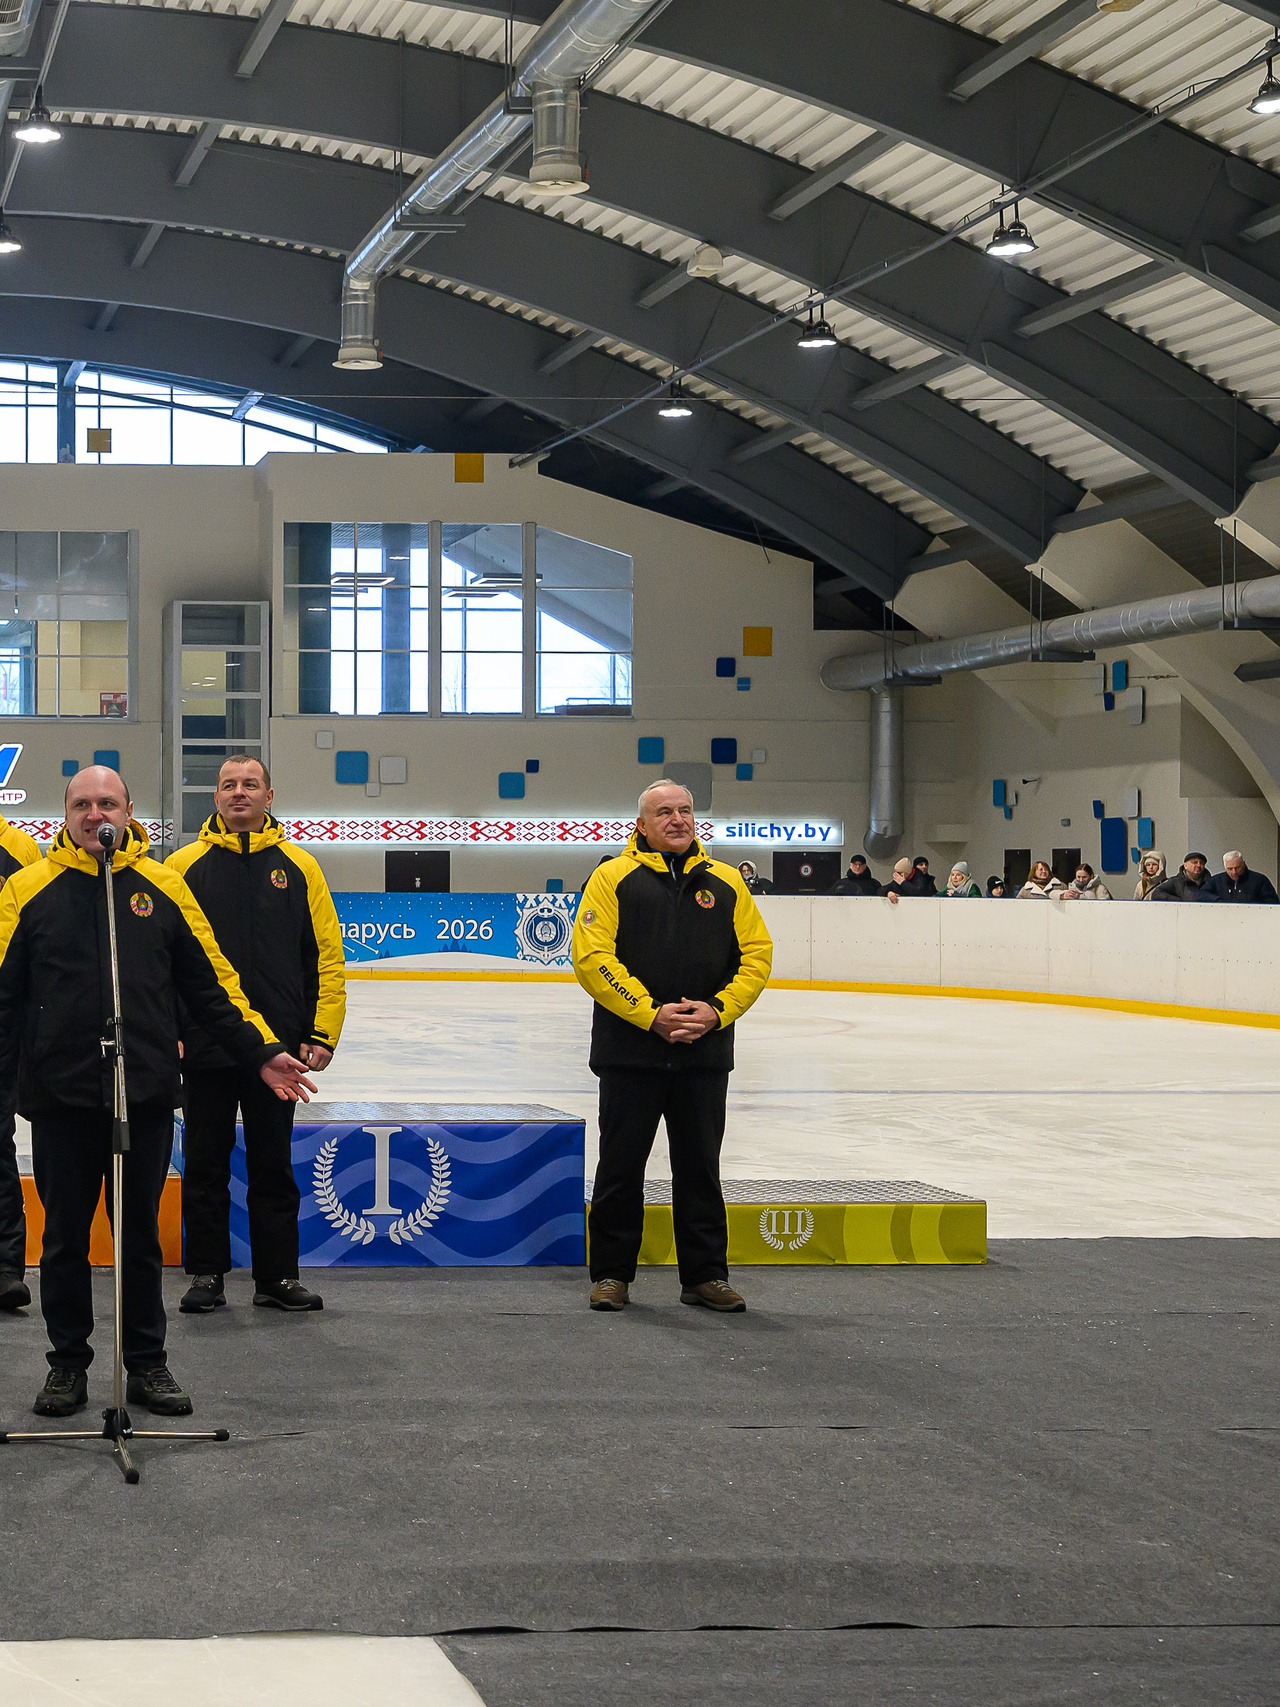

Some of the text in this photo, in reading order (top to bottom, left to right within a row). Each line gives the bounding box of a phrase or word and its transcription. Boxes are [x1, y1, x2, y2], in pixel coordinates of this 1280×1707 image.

[726, 823, 831, 841] silichy.by
[436, 919, 494, 940] 2026
[598, 964, 639, 1007] BELARUS
[768, 1210, 806, 1235] III
